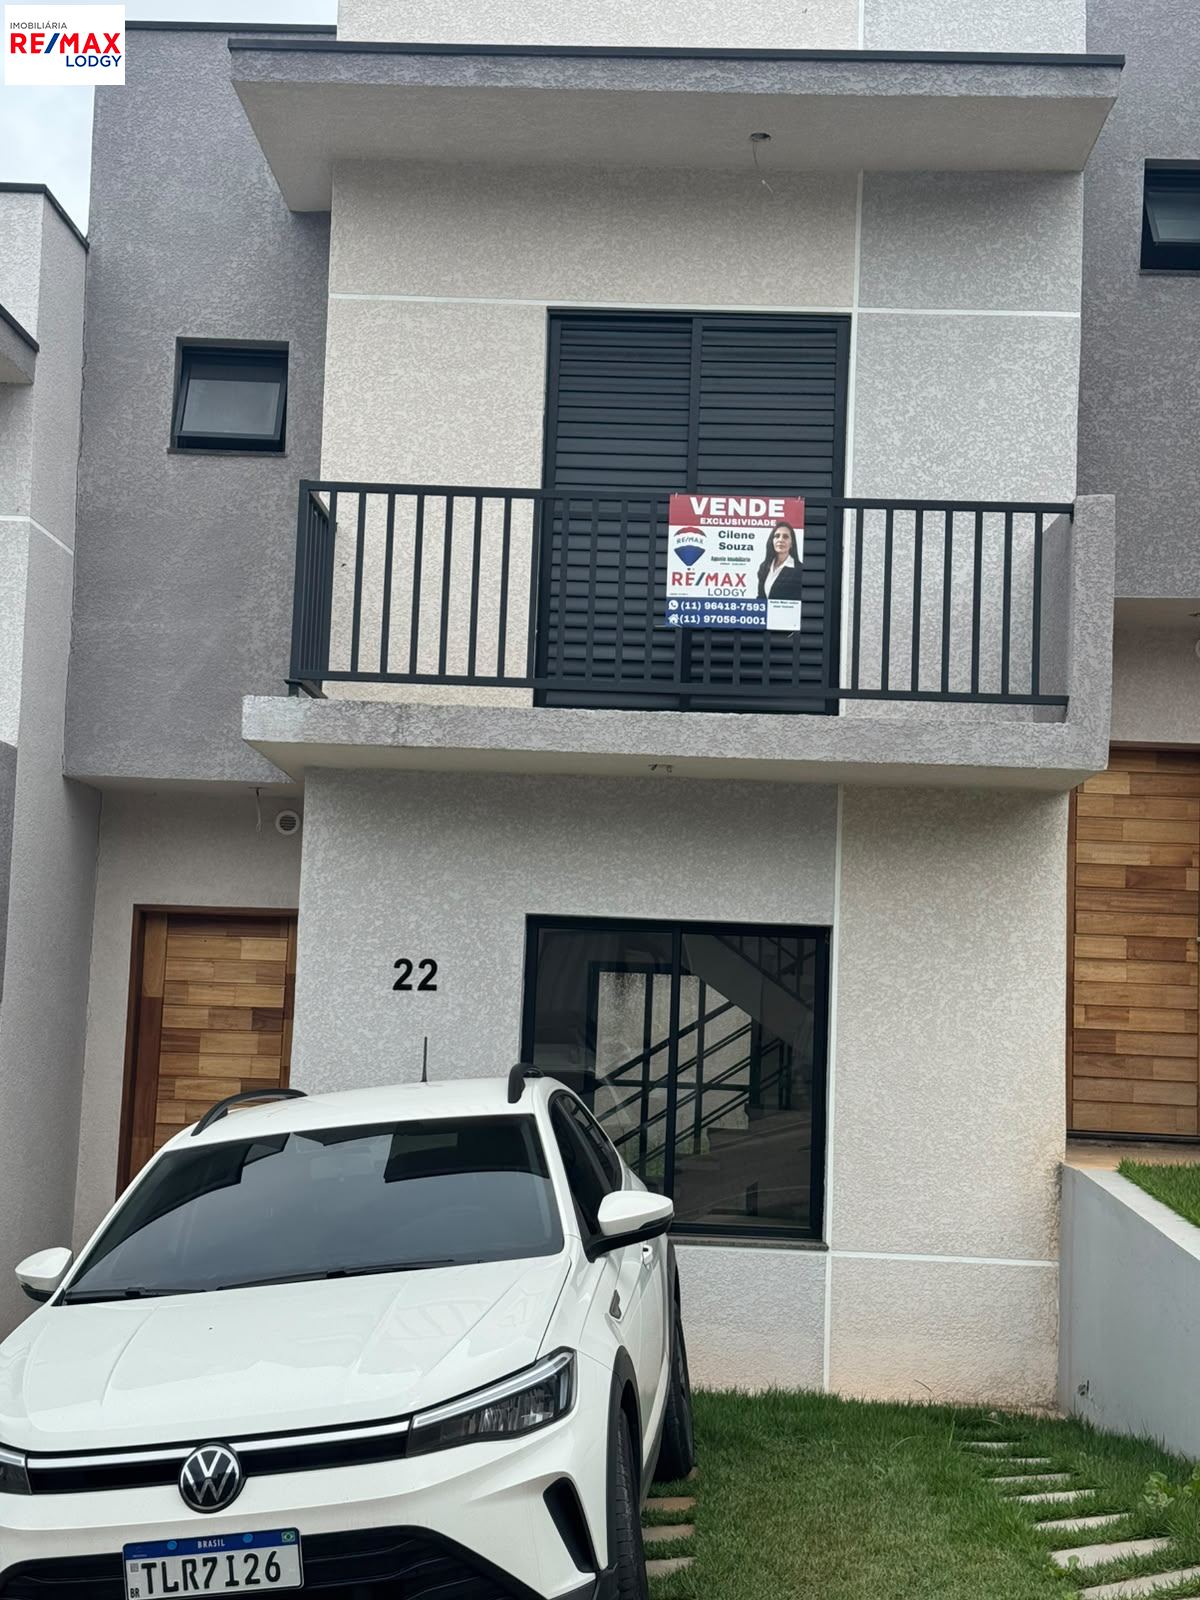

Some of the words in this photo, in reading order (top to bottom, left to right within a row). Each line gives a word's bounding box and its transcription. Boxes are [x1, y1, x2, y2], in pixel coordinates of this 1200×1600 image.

[690, 497, 785, 517] VENDE
[700, 518, 777, 527] EXCLUSIVIDADE
[718, 530, 755, 539] Cilene
[718, 542, 754, 551] Souza
[671, 571, 746, 587] RE/MAX
[707, 588, 747, 597] LODGY
[680, 601, 701, 611] (11)
[680, 614, 701, 624] (11)
[392, 958, 438, 991] 22
[197, 1539, 226, 1549] BRASIL
[130, 1588, 140, 1598] BR
